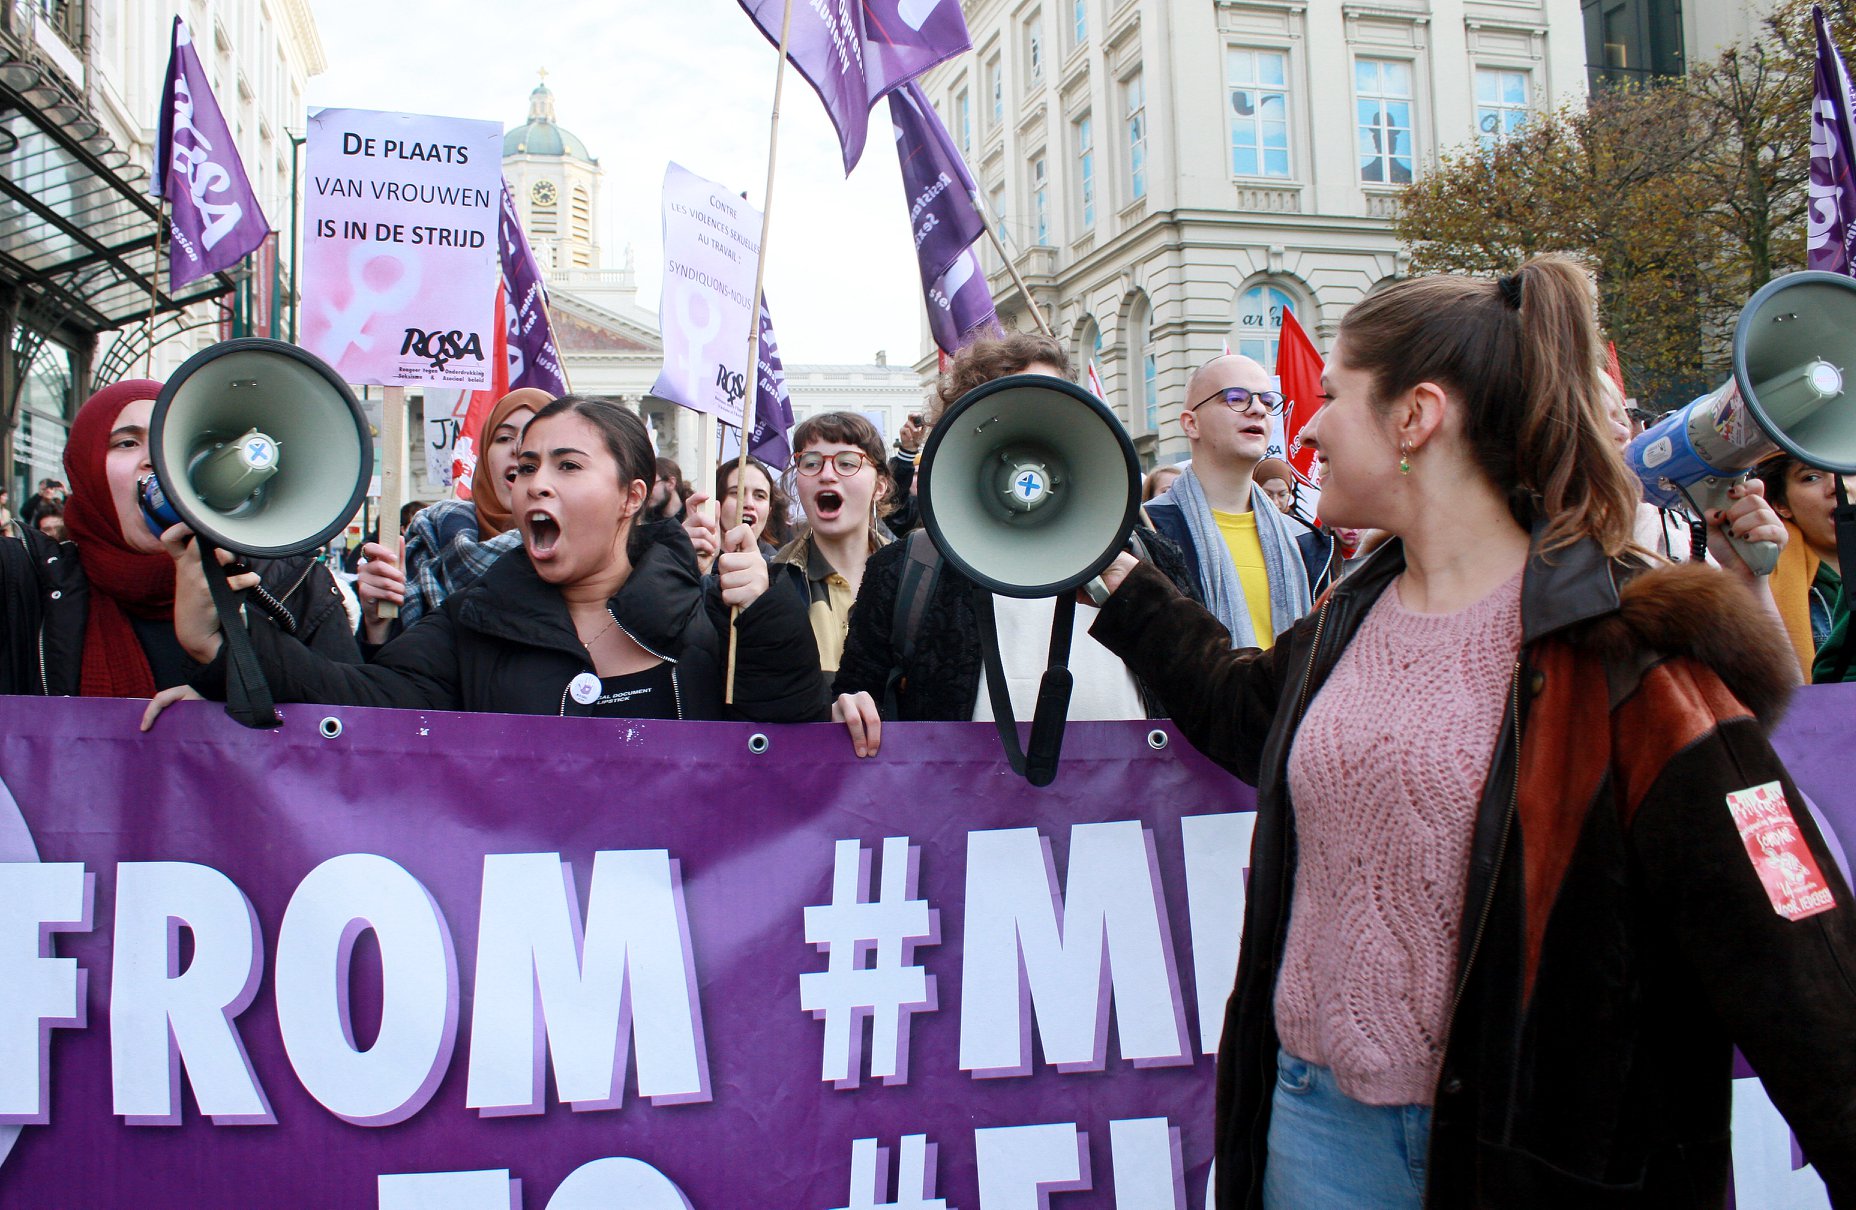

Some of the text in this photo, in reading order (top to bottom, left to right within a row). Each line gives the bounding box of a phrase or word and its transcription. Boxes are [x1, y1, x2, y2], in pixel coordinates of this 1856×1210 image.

[384, 139, 469, 165] PLAATS
[314, 176, 491, 208] VAN VROUWEN
[709, 194, 738, 220] CONTRE
[317, 218, 486, 249] IS IN DE STRIJD
[671, 202, 761, 256] LES VIOLENCES SEXUELLES
[697, 232, 710, 247] AU
[711, 238, 737, 264] TRAVAIL
[668, 259, 753, 311] SYNDIQUONS-NOUS
[400, 328, 485, 370] ROSA
[612, 687, 653, 699] DOCUMENT
[0, 849, 704, 1118] FROM
